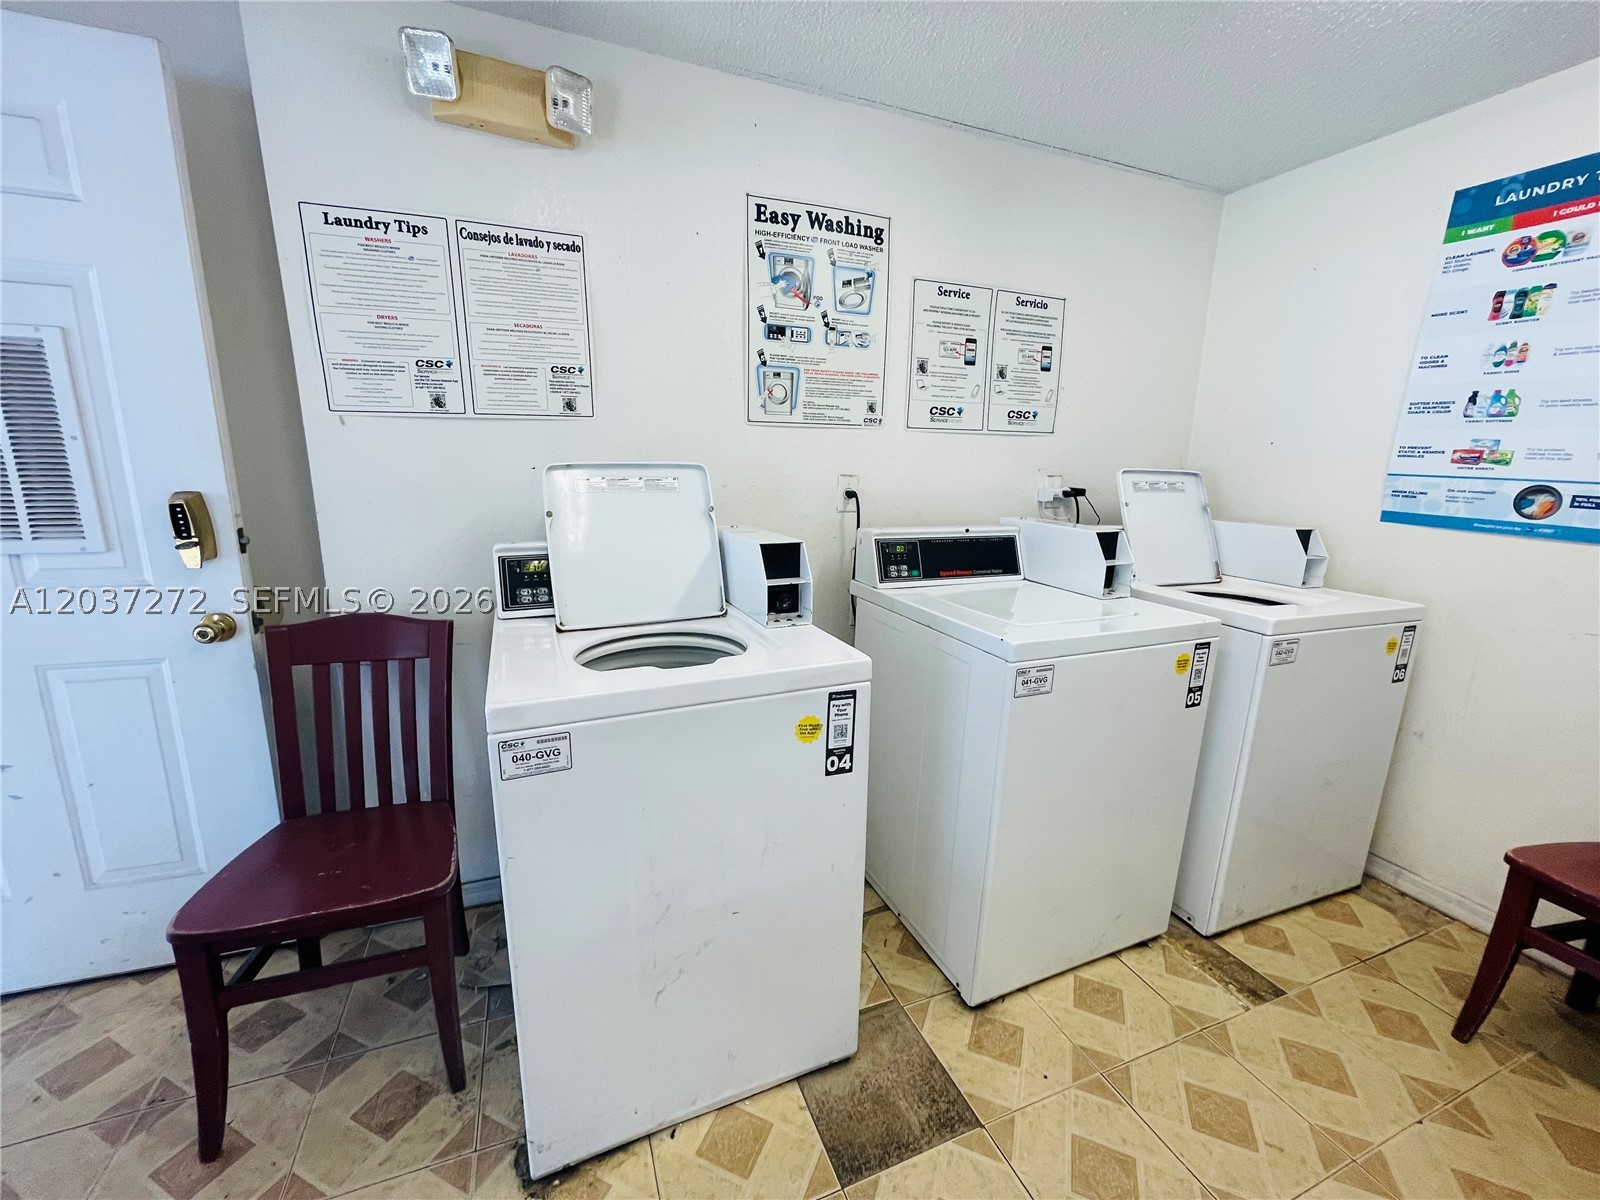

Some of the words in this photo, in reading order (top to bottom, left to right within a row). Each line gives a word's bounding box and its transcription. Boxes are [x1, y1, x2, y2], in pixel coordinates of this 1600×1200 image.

[1495, 173, 1589, 207] LAUNDRY
[1559, 201, 1597, 215] COULD
[321, 211, 391, 235] Laundry
[394, 219, 429, 238] Tips
[754, 203, 801, 233] Easy
[805, 210, 885, 246] Washing
[1466, 224, 1495, 235] WANT
[364, 236, 392, 244] WASHERS
[459, 226, 501, 246] Consejos
[503, 231, 514, 245] de
[515, 233, 544, 249] lavado
[545, 241, 551, 253] y
[552, 240, 581, 253] secado
[754, 229, 811, 243] HIGH-EFFICIENCY
[819, 237, 840, 246] FRONT
[842, 240, 858, 249] LOAD
[858, 243, 884, 253] WASHER
[508, 252, 538, 260] LAVADORAS
[937, 285, 971, 300] Service
[1015, 296, 1048, 310] Servicio
[415, 359, 444, 368] CSC
[550, 365, 576, 374] CSC
[929, 406, 956, 416] CSC
[1007, 410, 1031, 420] CSC
[1021, 676, 1048, 686] 041-GVG
[1393, 668, 1405, 680] 06
[1187, 691, 1201, 705] 05
[501, 742, 519, 750] CSC
[512, 748, 561, 764] 040-GVG
[826, 753, 852, 772] 04
